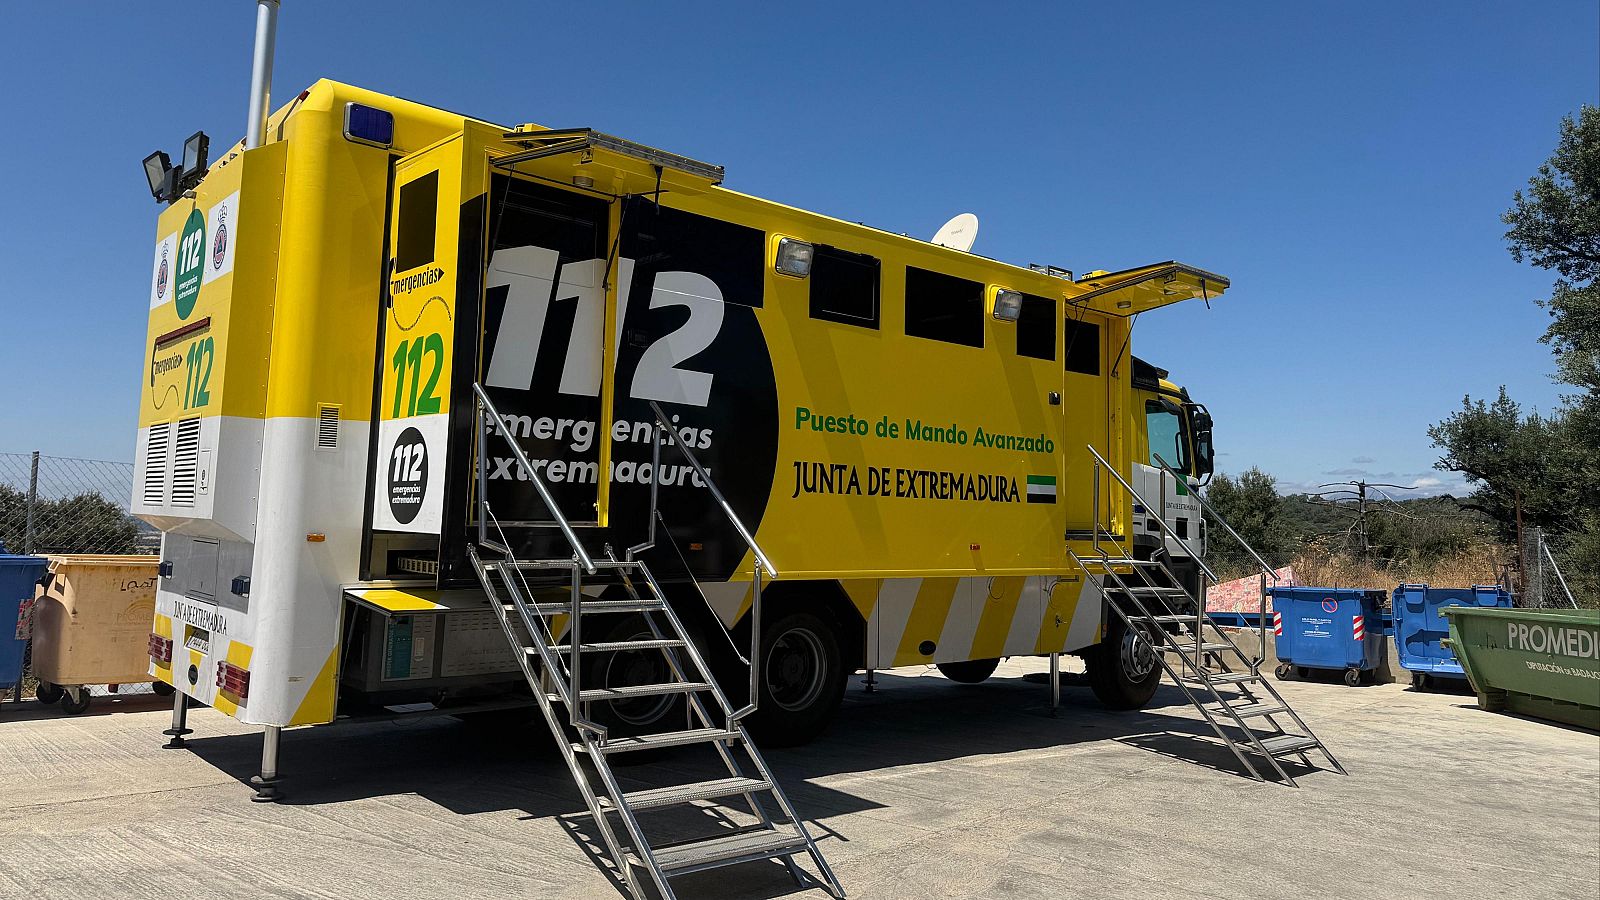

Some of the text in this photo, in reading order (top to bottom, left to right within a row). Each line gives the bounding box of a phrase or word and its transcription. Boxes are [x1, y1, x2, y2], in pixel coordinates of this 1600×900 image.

[180, 228, 203, 275] 112
[485, 245, 724, 407] 112
[184, 336, 214, 410] 112
[392, 332, 444, 418] 112
[795, 406, 1055, 453] Puesto de Mando Avanzado
[393, 442, 425, 482] 112
[791, 461, 1021, 503] JUNTA DE EXTREMADURA
[1507, 622, 1600, 660] PROMEDI
